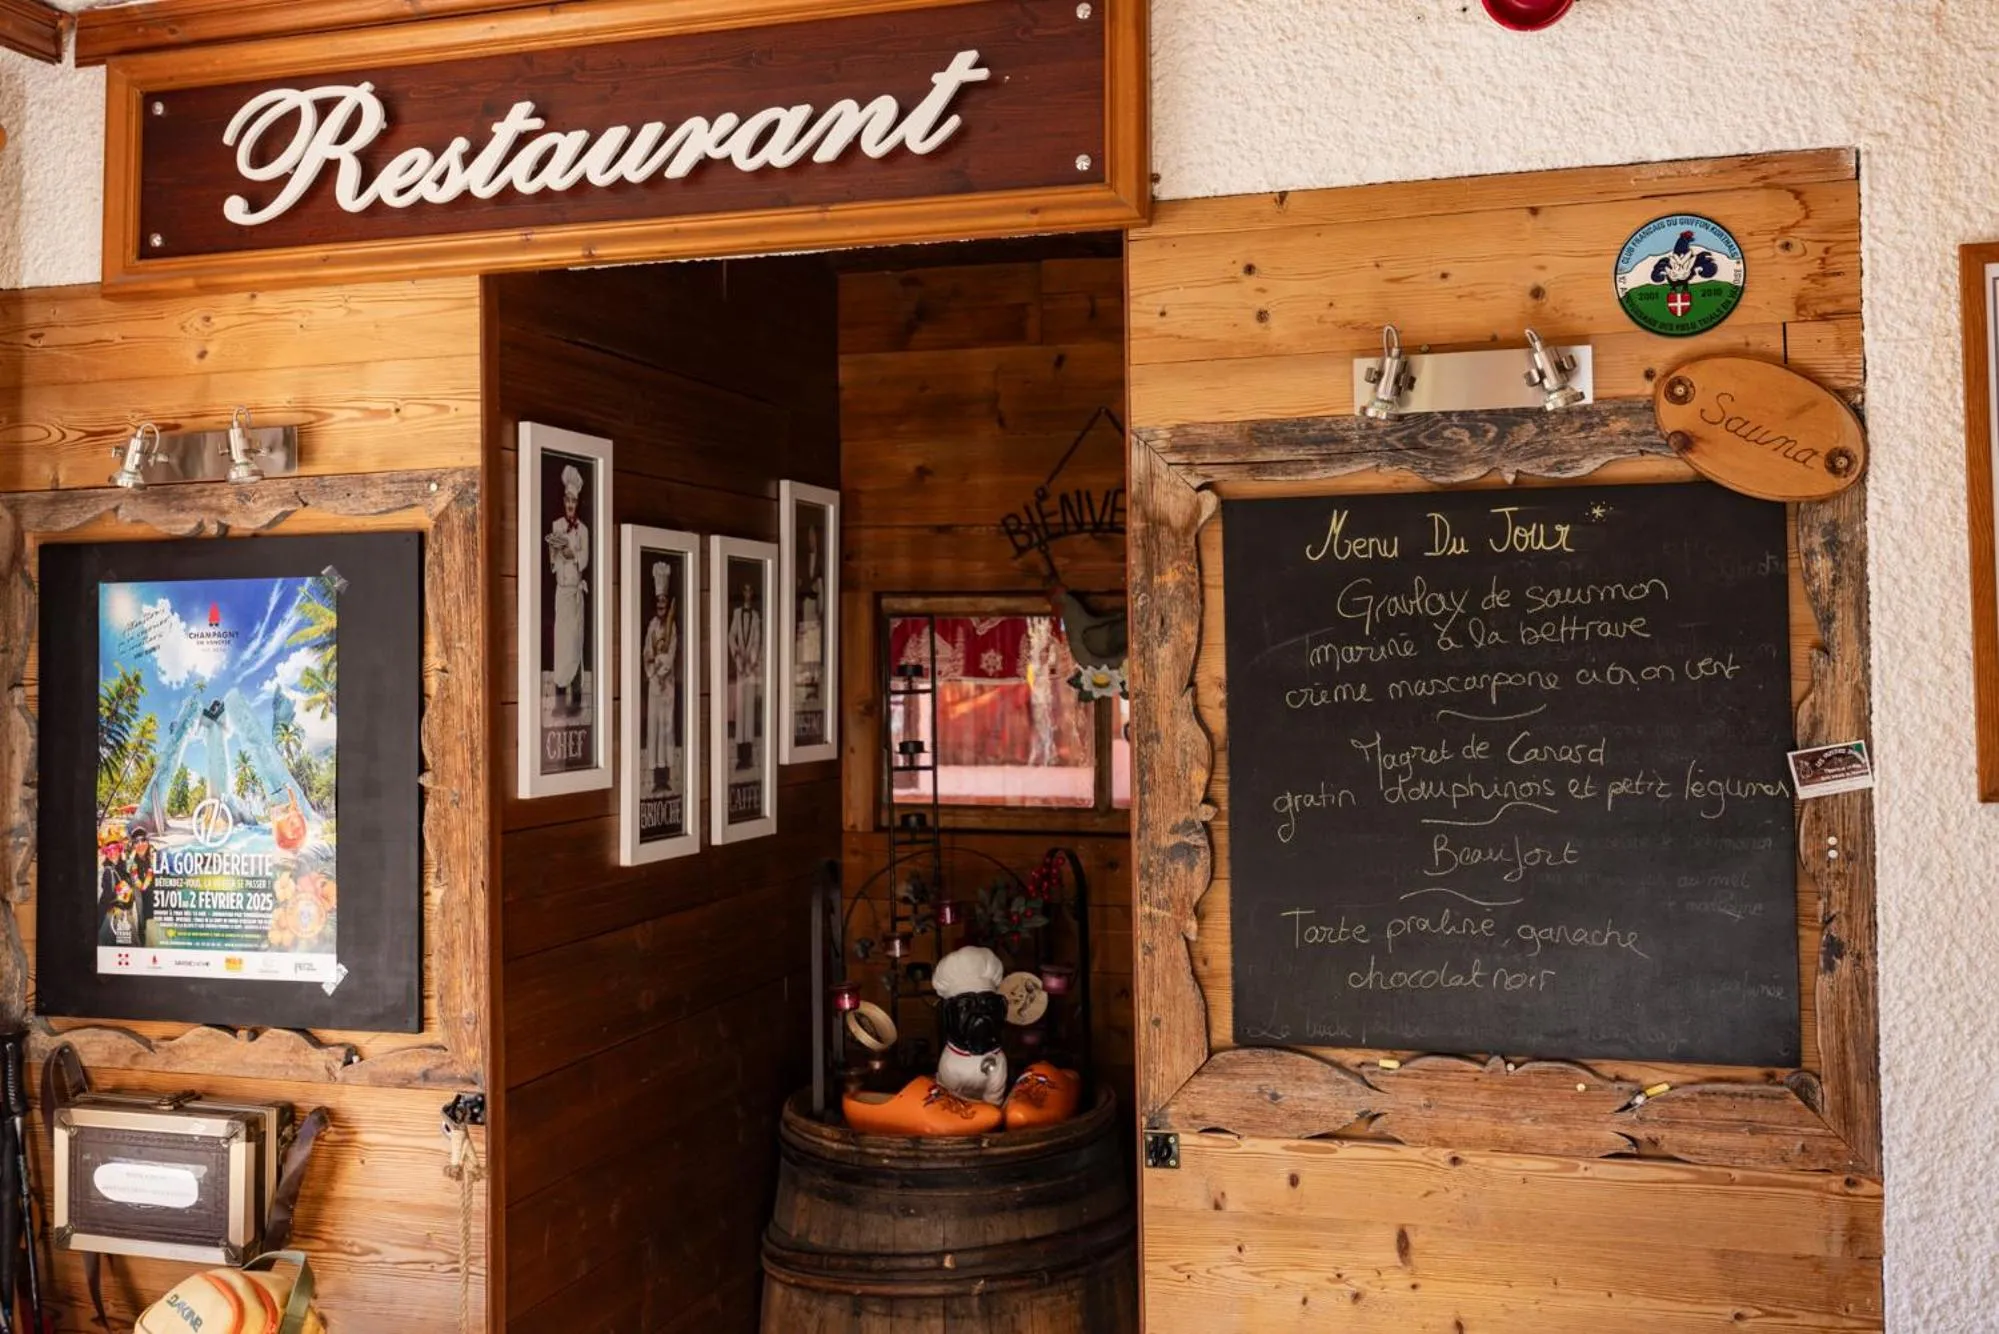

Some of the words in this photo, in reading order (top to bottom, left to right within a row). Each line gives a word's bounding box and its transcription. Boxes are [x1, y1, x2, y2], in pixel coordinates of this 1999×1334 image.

[222, 49, 990, 227] Restaurant
[1699, 392, 1821, 470] Sauna
[1304, 508, 1399, 562] Menu
[1423, 512, 1469, 557] Du
[1488, 506, 1576, 554] Jour
[1480, 575, 1511, 611] de
[1525, 577, 1669, 615] saumon
[1468, 616, 1509, 649] la
[1387, 670, 1561, 706] mascarpone
[1575, 655, 1675, 687] citron
[1684, 651, 1741, 681] vert
[545, 728, 588, 760] CHEF
[1350, 731, 1454, 791] Magret
[1461, 733, 1490, 760] de
[1506, 730, 1607, 766] Canard
[639, 797, 683, 830] BRIOCHE
[1272, 772, 1357, 844] gratin
[1384, 768, 1557, 811] dauphinois
[1568, 774, 1600, 800] et
[152, 852, 170, 875] LA
[173, 852, 274, 876] GORZDERETTE
[1423, 833, 1578, 883] Beaufort
[152, 889, 182, 909] 31/01
[189, 891, 197, 909] 2
[199, 889, 243, 910] FÉVRIER
[245, 892, 274, 911] 2025
[1280, 906, 1370, 948] Tarte
[1516, 918, 1649, 959] ganache
[1348, 955, 1487, 990] chocolat
[1492, 967, 1556, 991] noir
